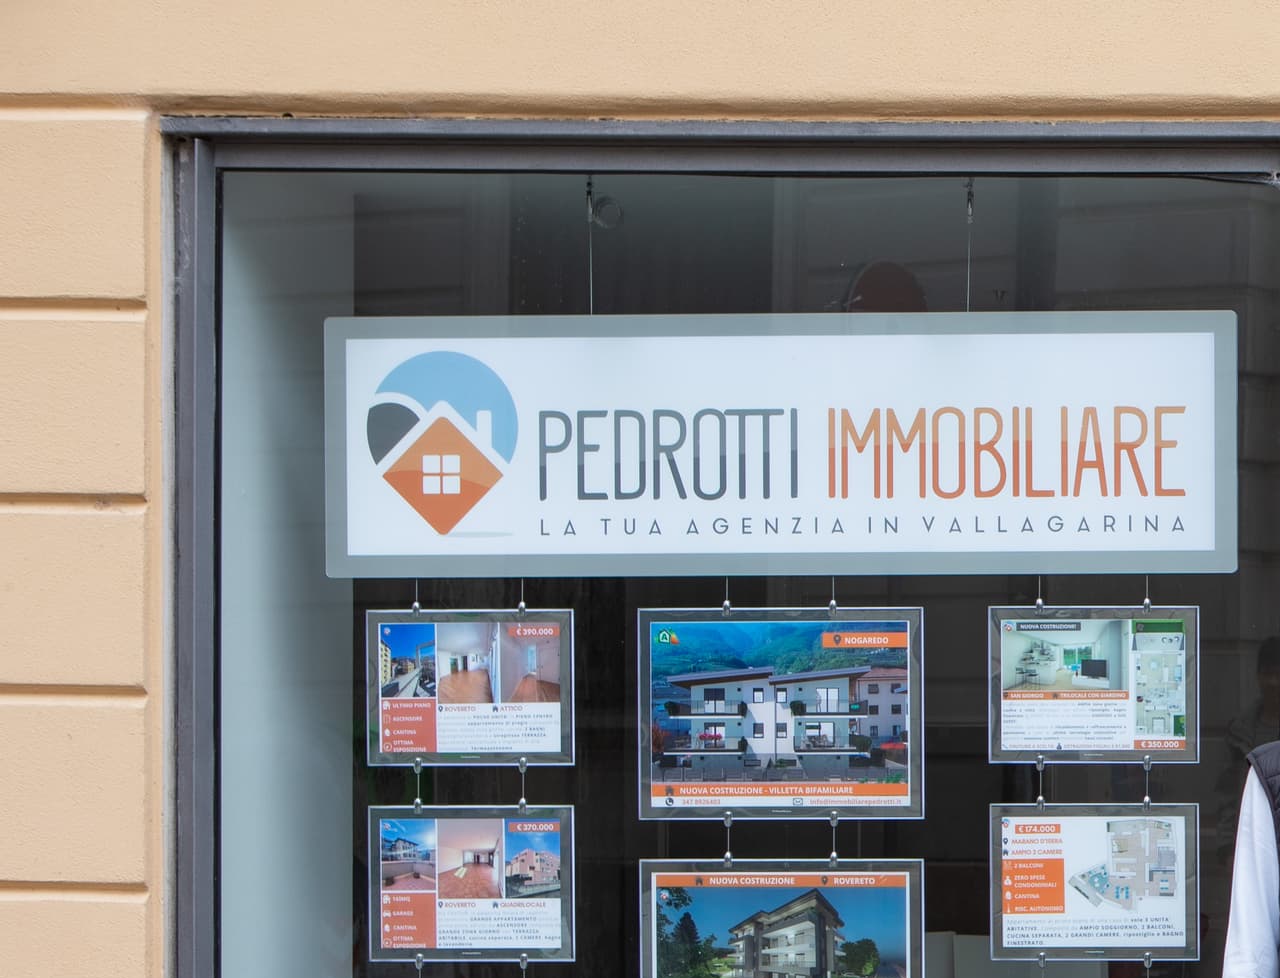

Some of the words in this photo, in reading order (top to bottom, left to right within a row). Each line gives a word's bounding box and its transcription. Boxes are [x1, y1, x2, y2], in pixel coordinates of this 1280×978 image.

[538, 408, 799, 501] PEDROTTI
[826, 404, 1188, 500] IMMOBILIARE
[539, 519, 578, 537] LA
[600, 519, 664, 536] TUA
[686, 518, 845, 536] AGENZIA
[867, 518, 900, 535] IN
[922, 515, 1186, 534] VALLAGARINA
[845, 636, 888, 645] NOGAREDO
[679, 786, 708, 794] NUOVA
[710, 786, 762, 794] COSTRUZIONE
[769, 786, 803, 794] VILLETTA
[805, 786, 853, 794] BIFAMILIARE
[1025, 825, 1055, 833] 174.000
[709, 877, 738, 885] NUOVA
[740, 877, 795, 885] COSTRUZIONE
[833, 877, 875, 885] ROVERETO
